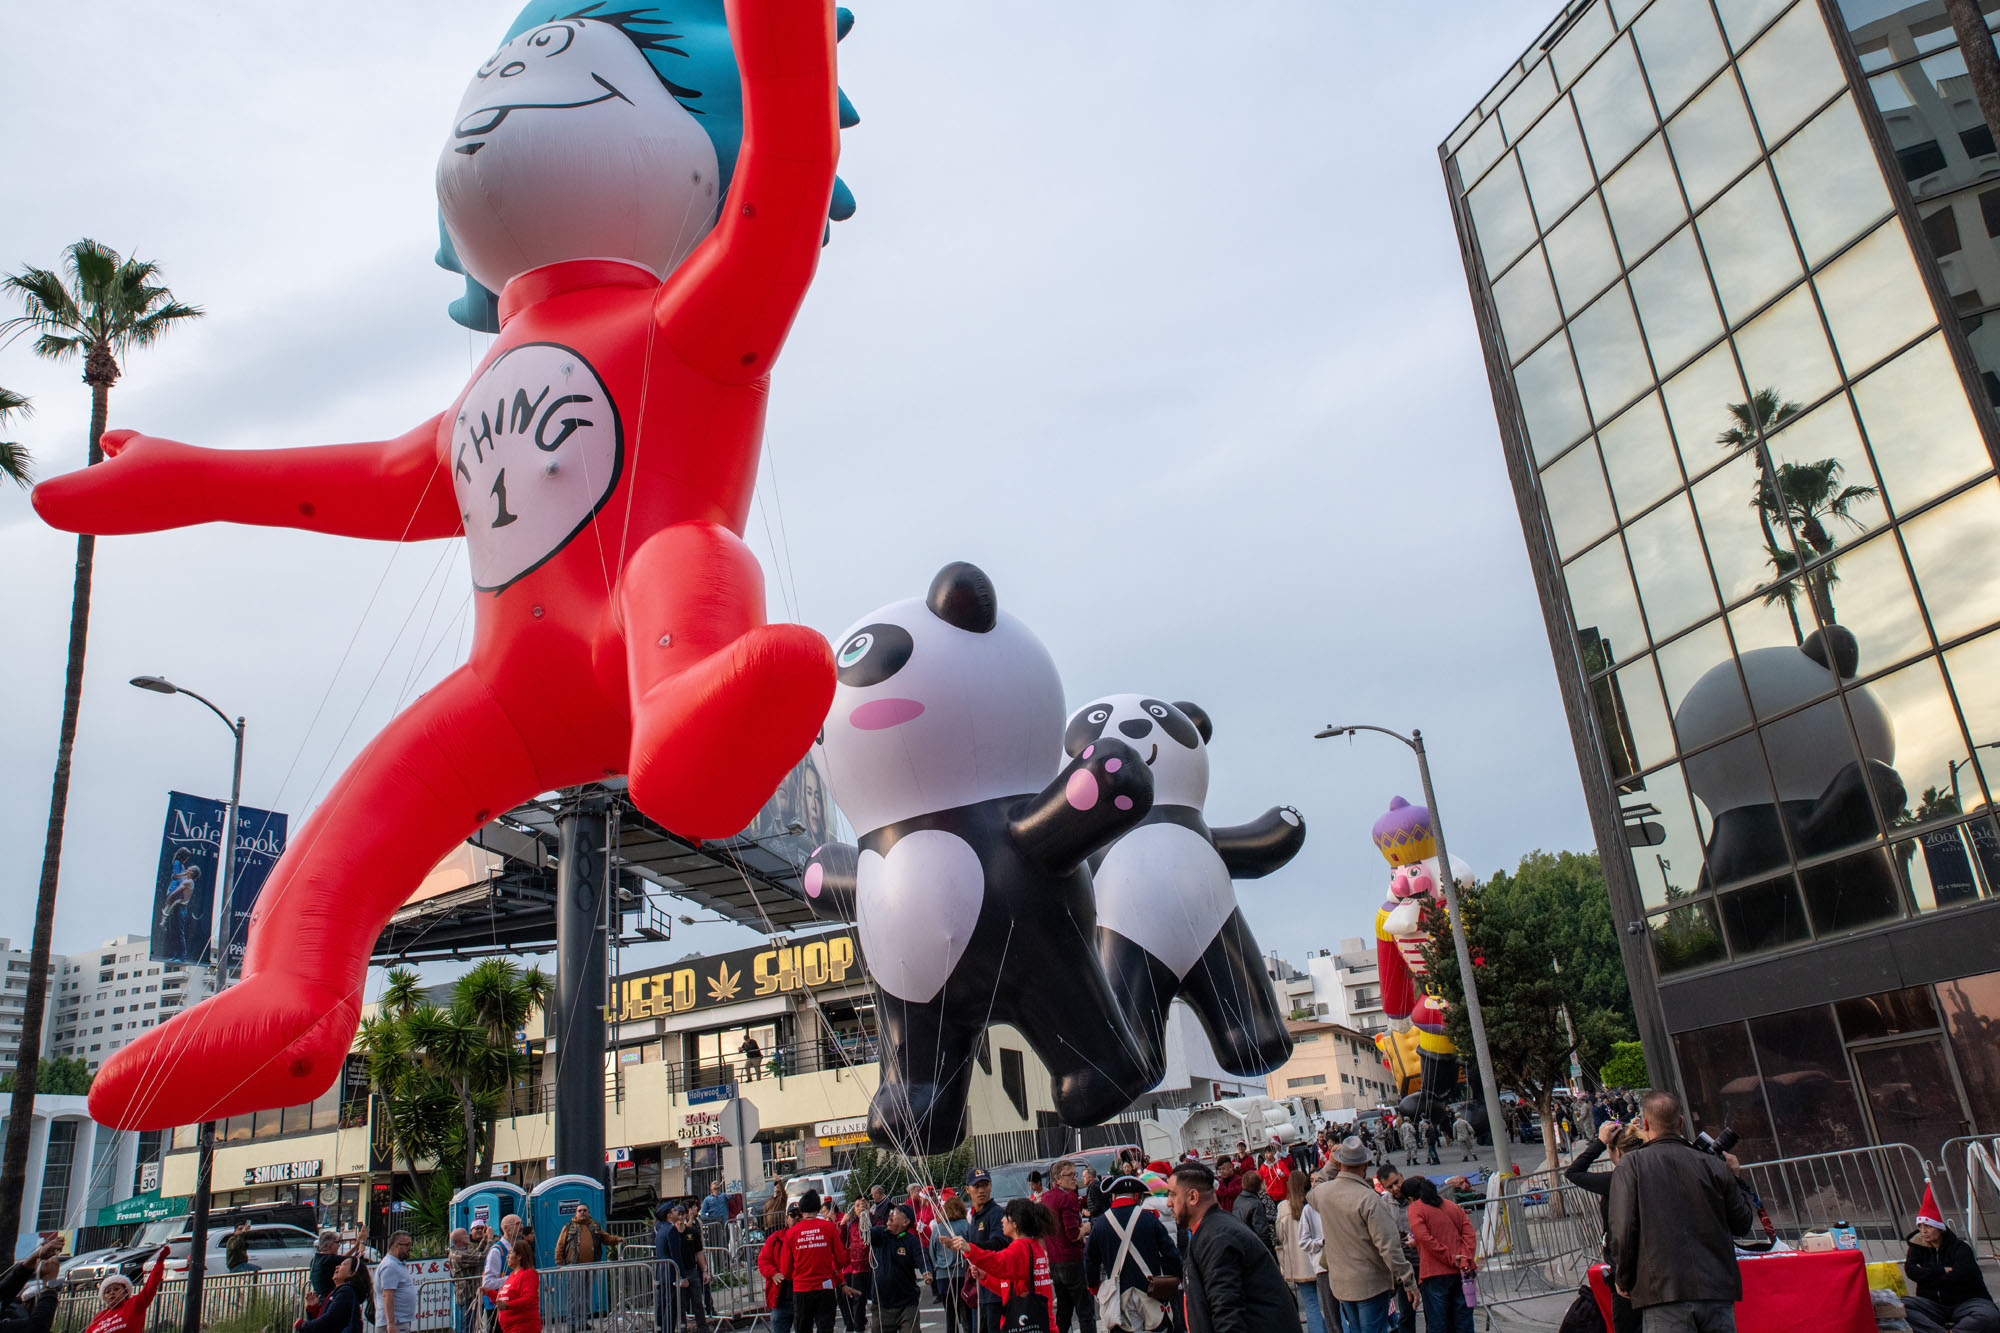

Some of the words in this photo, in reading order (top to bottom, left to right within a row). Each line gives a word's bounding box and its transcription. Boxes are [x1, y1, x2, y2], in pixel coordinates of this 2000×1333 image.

[456, 385, 594, 485] THING
[489, 467, 518, 529] 1
[753, 937, 854, 996] SHOP
[688, 1088, 720, 1100] Hollywood
[685, 1112, 720, 1126] Hollyw
[678, 1125, 702, 1139] Gold
[821, 1123, 867, 1135] CLEANER
[691, 1135, 728, 1146] EXCHANG
[254, 1164, 290, 1183] SMOKE
[291, 1160, 321, 1179] SHOP
[142, 1178, 157, 1190] 30
[116, 1212, 142, 1221] Frozen
[143, 1208, 169, 1218] Yogurt
[406, 1263, 425, 1275] UY
[428, 1262, 440, 1273] &
